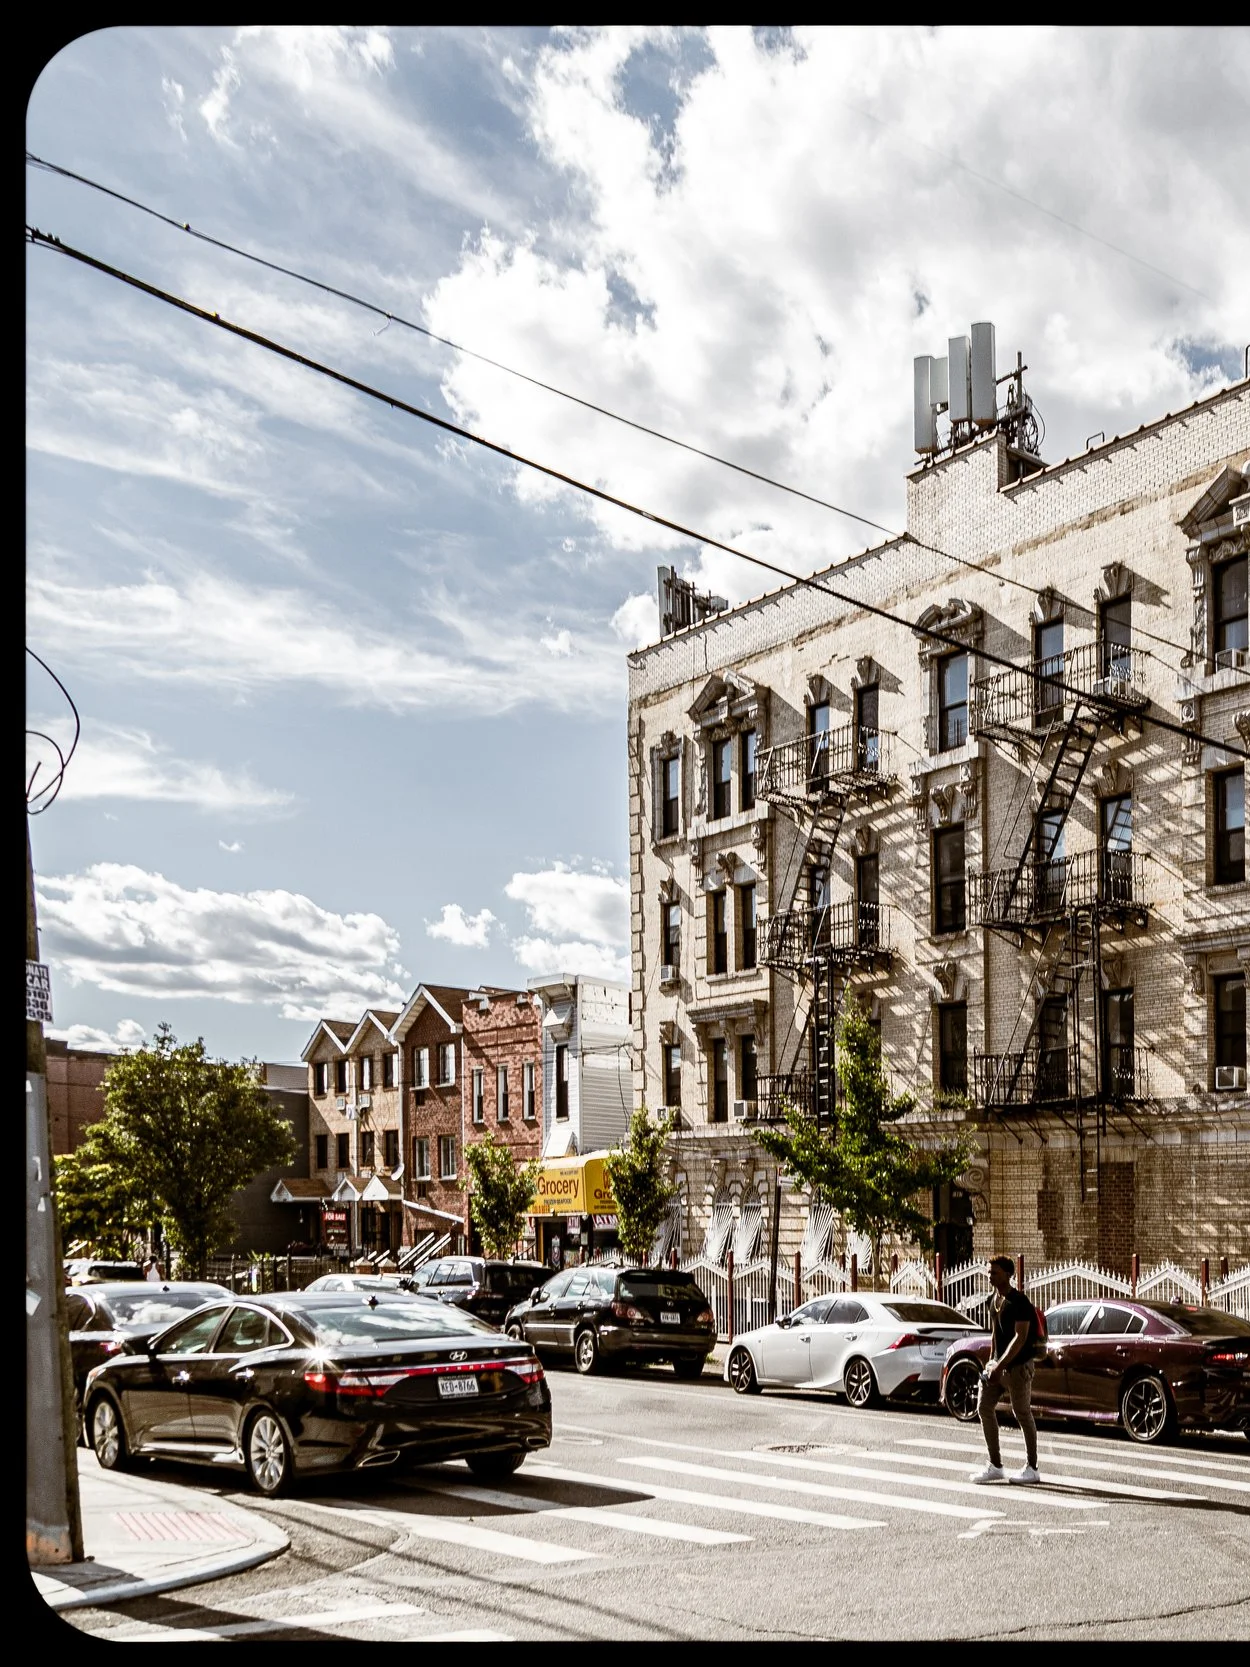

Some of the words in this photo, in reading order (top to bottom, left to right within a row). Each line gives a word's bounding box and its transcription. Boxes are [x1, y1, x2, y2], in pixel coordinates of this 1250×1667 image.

[26, 975, 49, 990] CAR
[537, 1176, 579, 1198] Grocery
[325, 1212, 335, 1220] FOR
[596, 1214, 619, 1225] ATM
